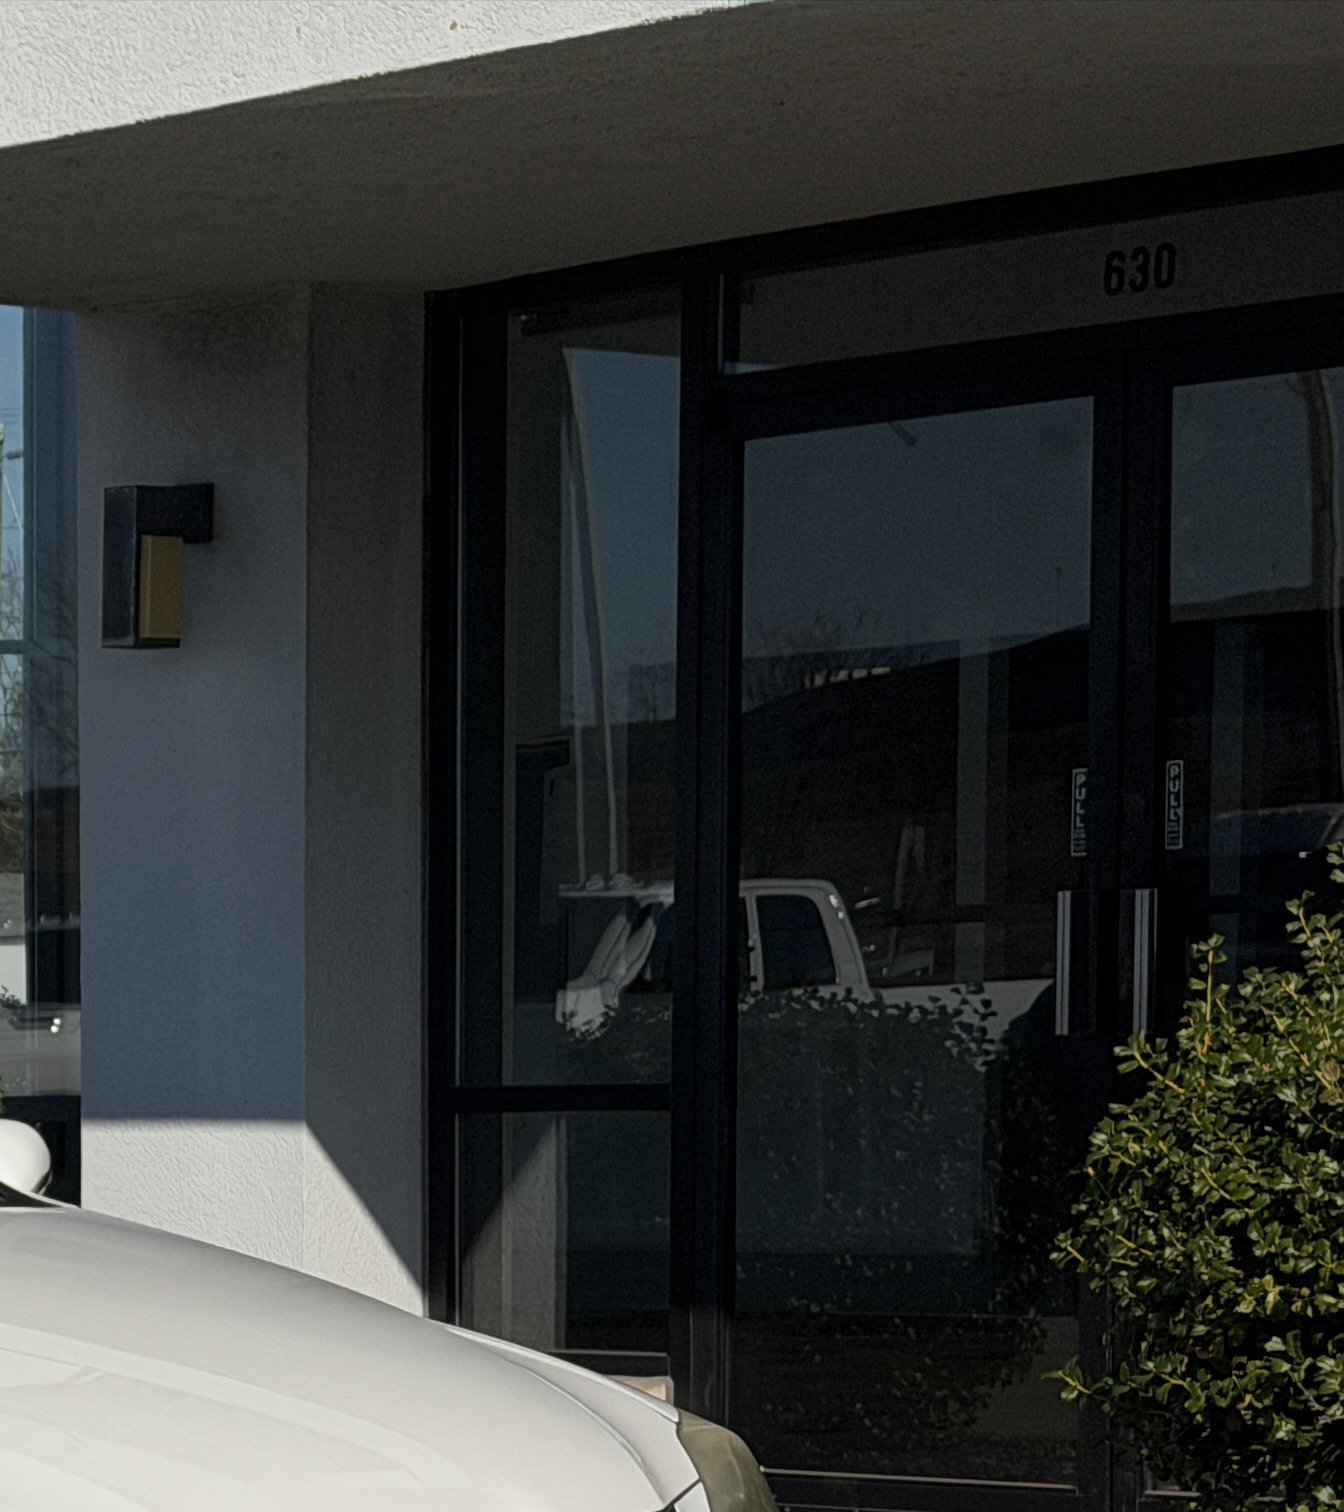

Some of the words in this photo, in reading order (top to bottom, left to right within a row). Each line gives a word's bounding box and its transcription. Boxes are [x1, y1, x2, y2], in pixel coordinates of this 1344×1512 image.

[1104, 242, 1176, 295] 630
[1075, 773, 1087, 828] PULL
[1169, 765, 1180, 821] PULL
